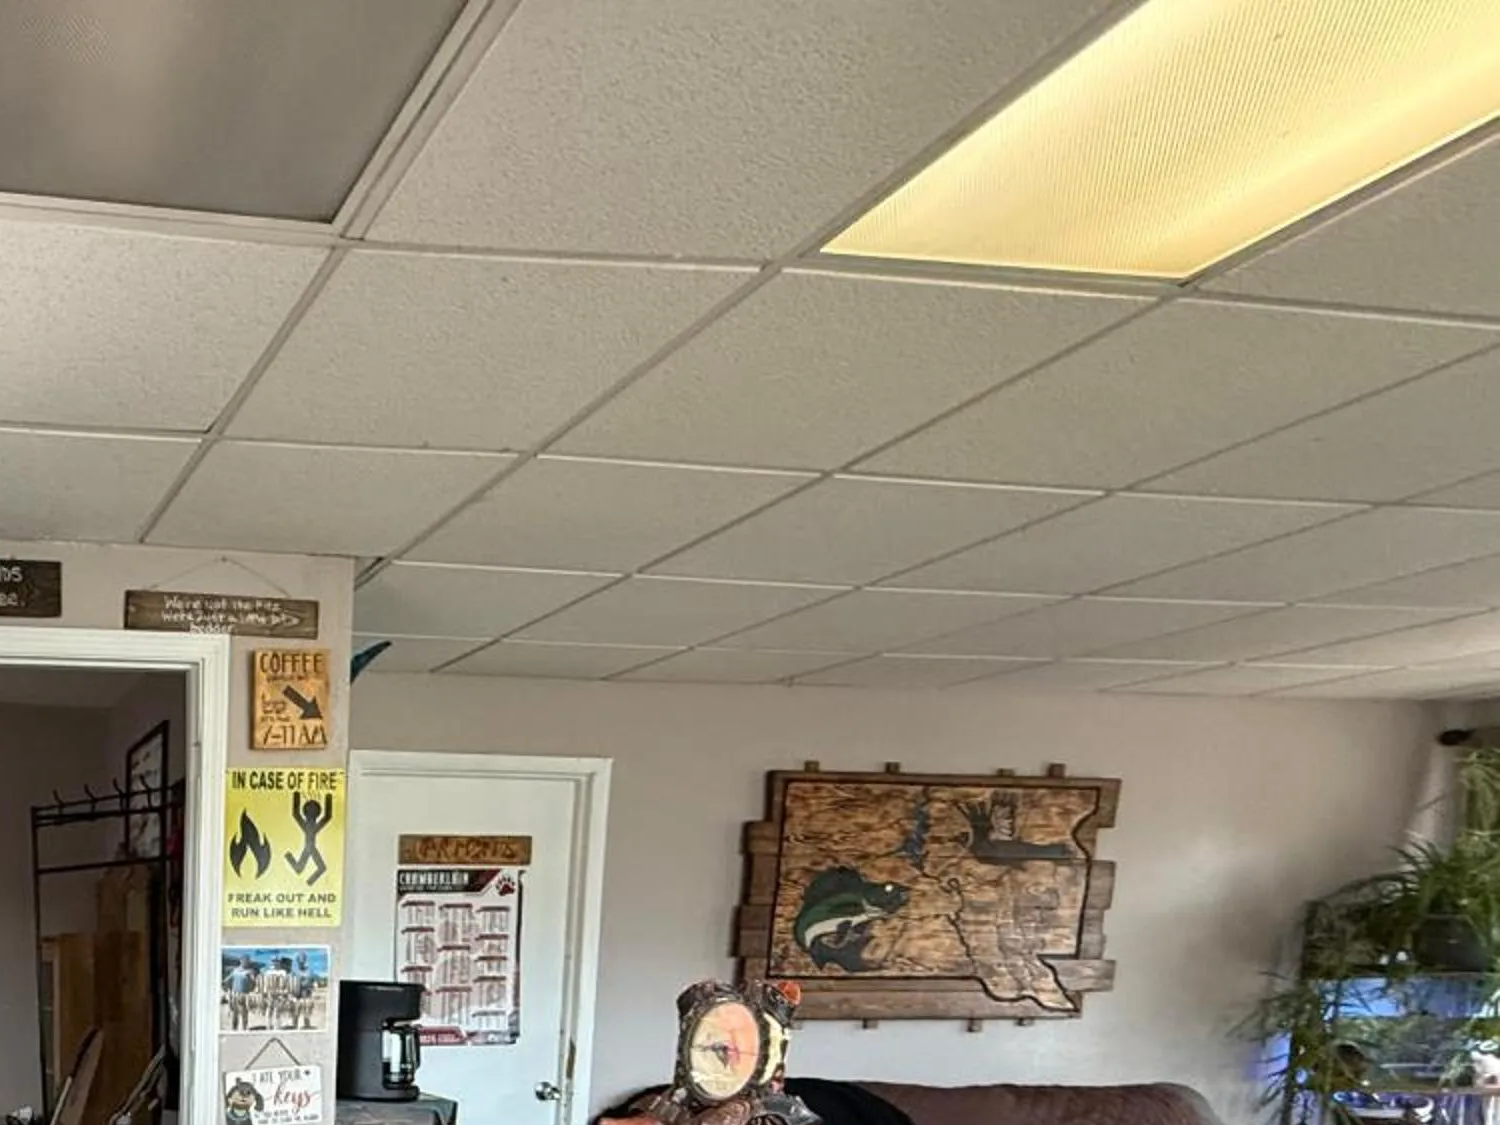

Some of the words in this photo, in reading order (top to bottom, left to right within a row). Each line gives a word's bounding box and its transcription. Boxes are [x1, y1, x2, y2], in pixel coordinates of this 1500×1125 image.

[232, 771, 246, 789] IN
[250, 771, 284, 790] CASE
[288, 771, 305, 790] OF
[308, 771, 337, 790] FIRE
[227, 893, 272, 903] FREAK
[276, 893, 305, 903] OUT
[307, 893, 336, 903] AND
[231, 908, 260, 918] RUN
[263, 908, 295, 918] LIKE
[298, 908, 332, 919] HELL
